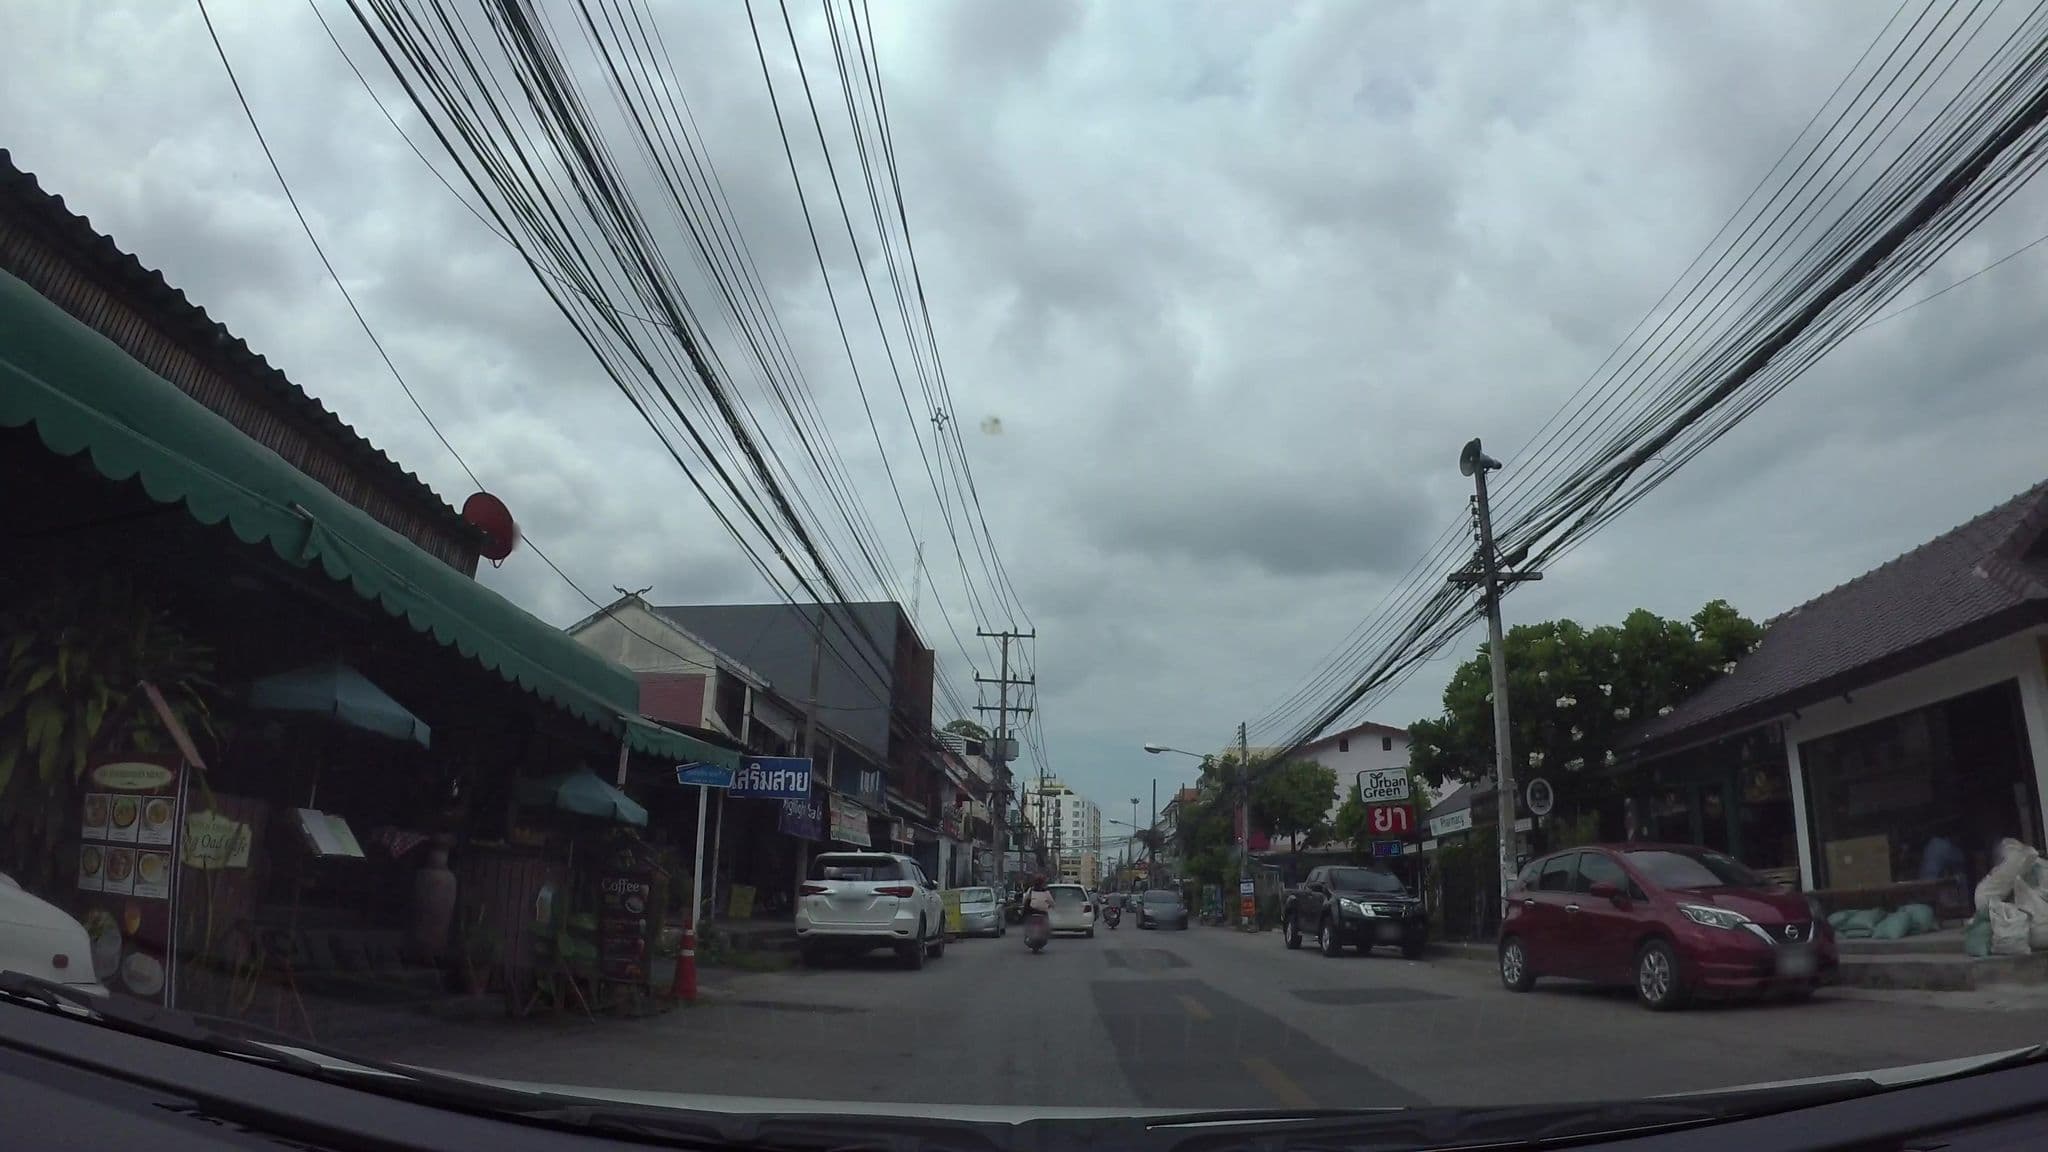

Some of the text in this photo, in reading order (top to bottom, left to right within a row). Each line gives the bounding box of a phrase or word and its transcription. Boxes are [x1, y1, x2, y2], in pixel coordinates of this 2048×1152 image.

[1370, 775, 1407, 789] Urban
[1363, 786, 1401, 799] Green
[1374, 806, 1407, 831] ยา
[601, 878, 640, 895] Coffee
